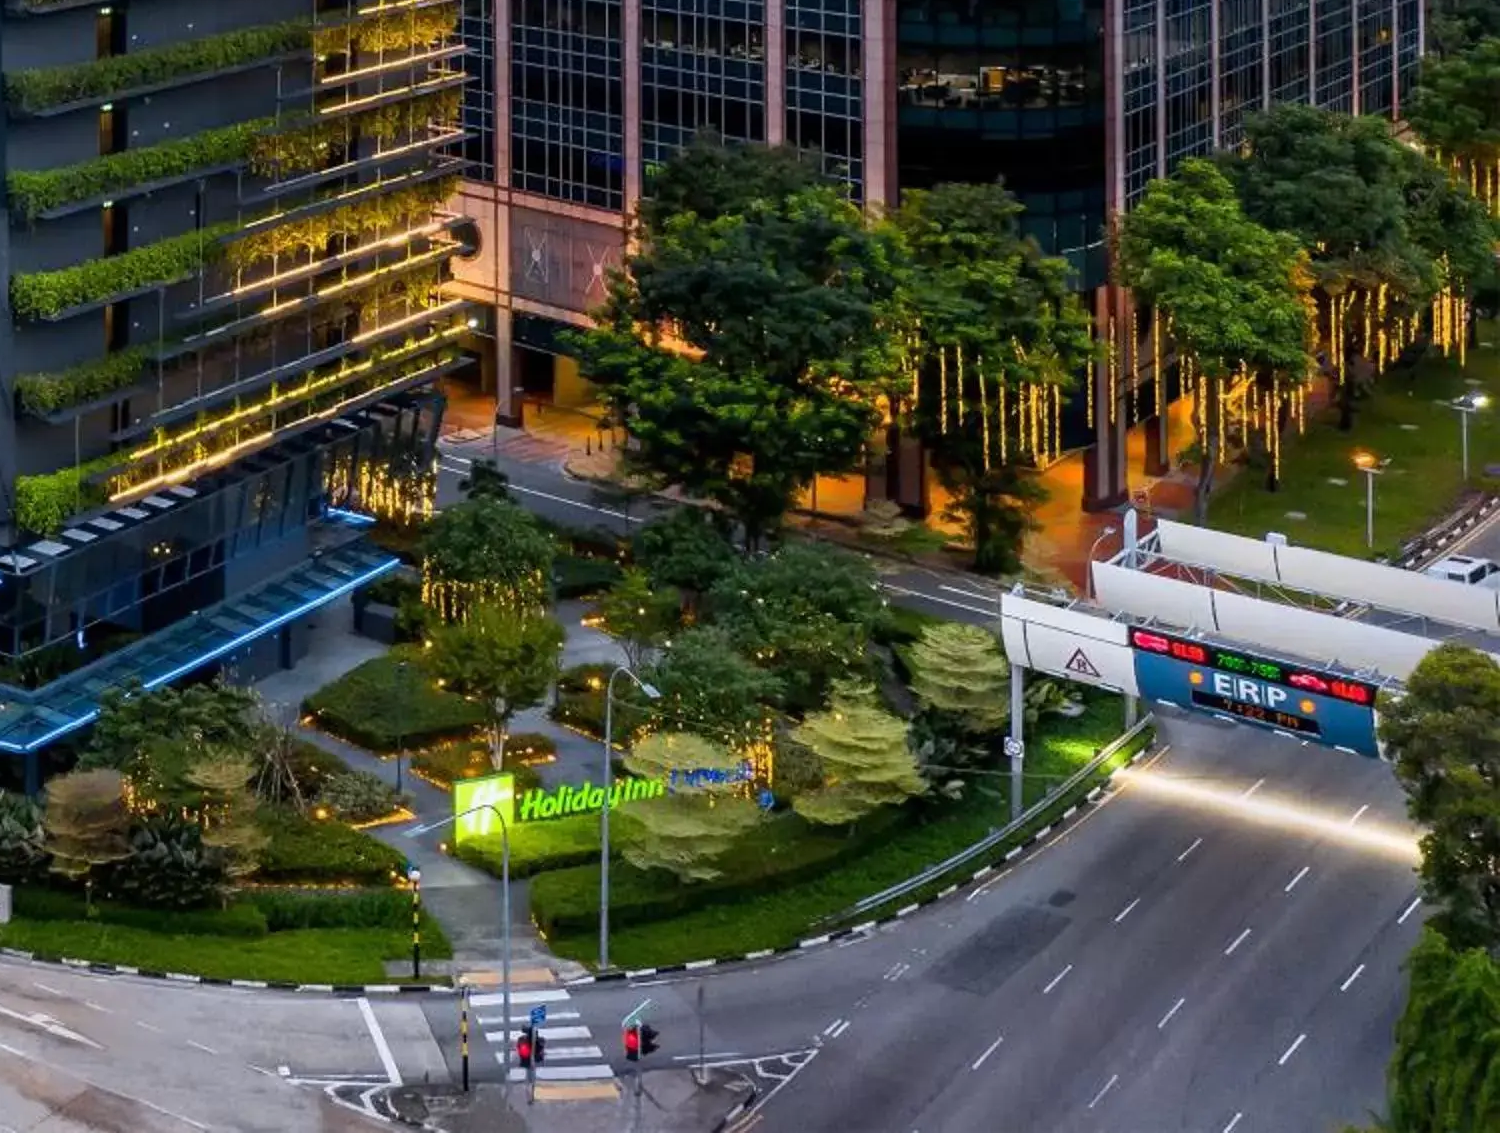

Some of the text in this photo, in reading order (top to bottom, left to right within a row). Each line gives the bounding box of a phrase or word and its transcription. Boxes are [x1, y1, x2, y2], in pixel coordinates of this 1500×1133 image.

[1213, 673, 1287, 707] ERP
[519, 781, 620, 820] Holiday
[623, 776, 664, 801] Inn
